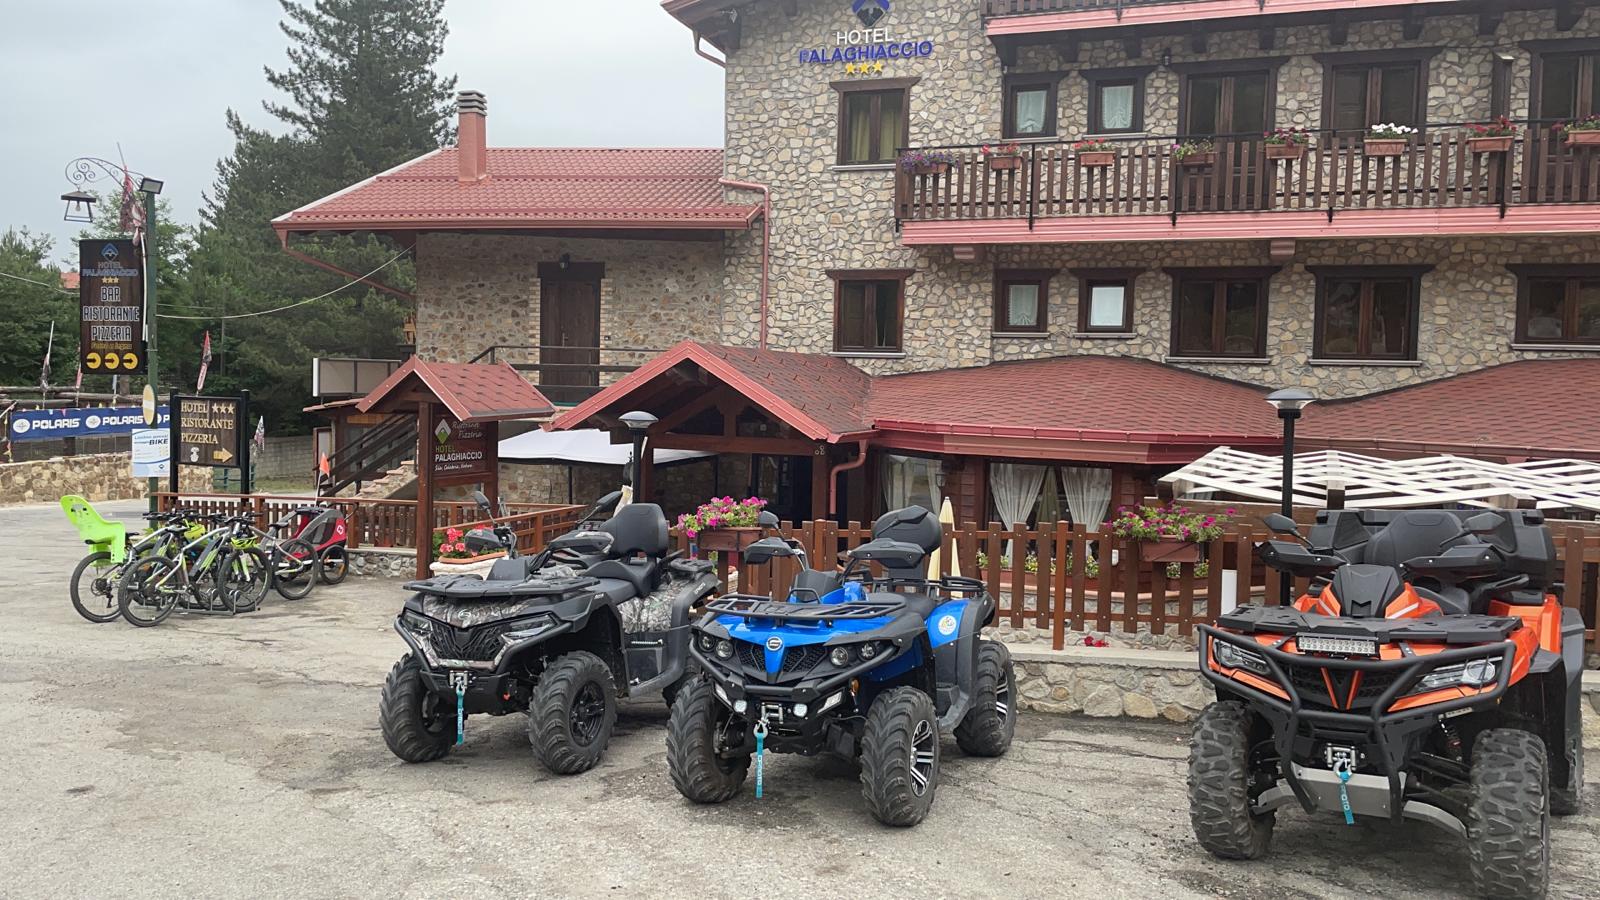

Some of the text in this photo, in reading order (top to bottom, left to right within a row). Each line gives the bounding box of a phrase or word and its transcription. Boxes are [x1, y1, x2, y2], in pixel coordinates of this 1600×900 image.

[836, 27, 895, 46] HOTEL
[798, 40, 934, 64] PALAGHIACCIO
[98, 261, 123, 269] HOTEL
[100, 286, 121, 302] BAR
[83, 306, 140, 322] RISTORANTE
[91, 325, 132, 342] PIZZERIA
[181, 402, 209, 413] HOTEL
[32, 418, 81, 430] POLARIS
[102, 415, 143, 426] POLARIS
[181, 417, 234, 429] RISTORANTE
[181, 432, 219, 444] PIZZERIA
[435, 445, 455, 453] HOTEL
[435, 451, 483, 462] PALAGHIACCIO
